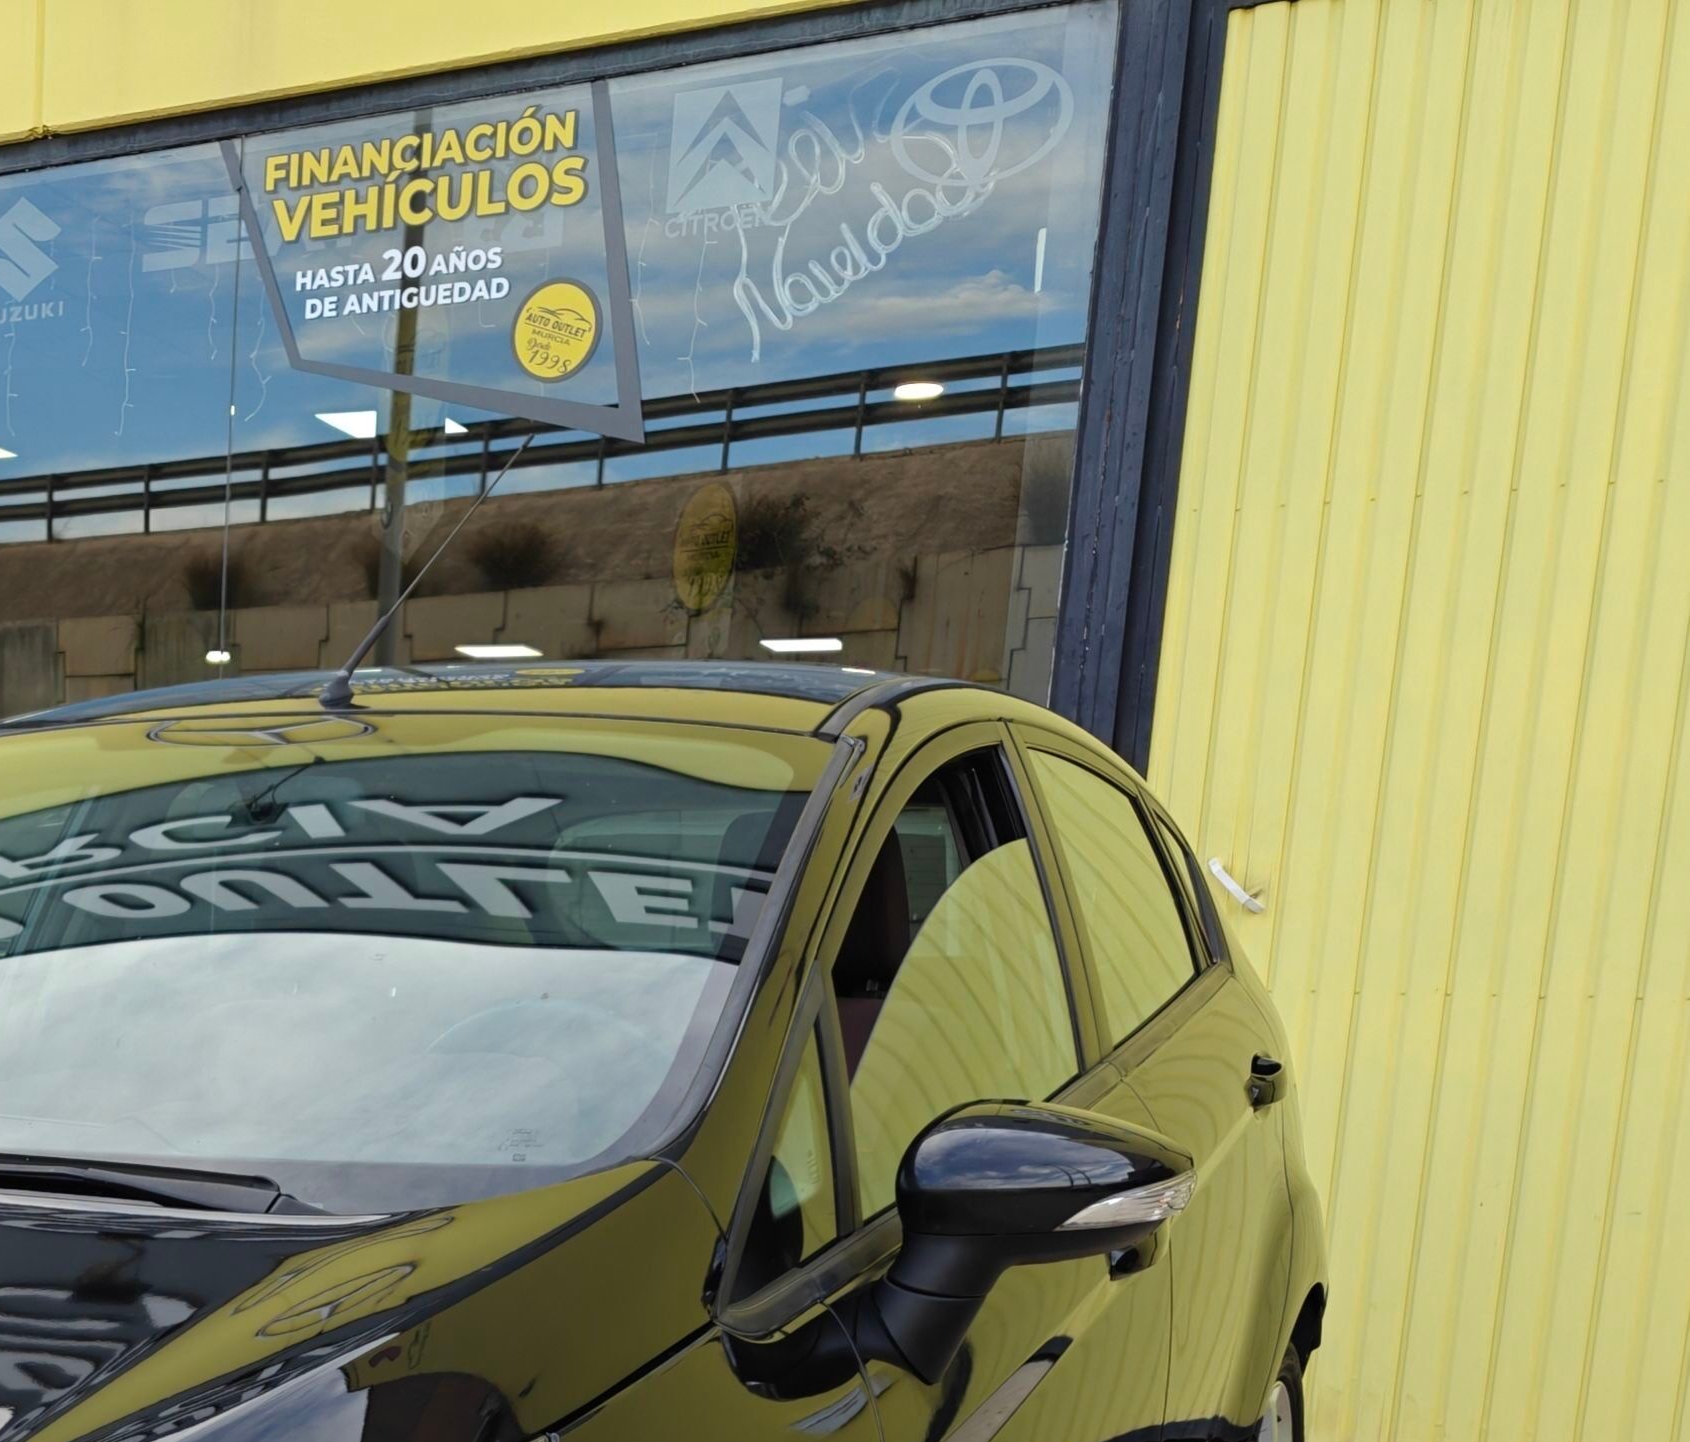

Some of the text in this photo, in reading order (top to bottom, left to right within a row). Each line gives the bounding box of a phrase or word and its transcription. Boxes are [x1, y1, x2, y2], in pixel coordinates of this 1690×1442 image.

[263, 106, 578, 193] FINANCIACIÓN
[272, 155, 588, 242] VEHÍCULOS
[295, 246, 503, 292] HASTA 20 AÑOS
[304, 276, 511, 320] DE ANTIGUEDAD
[525, 312, 587, 339] AUTO OUTLET
[531, 328, 571, 346] MURCIA
[529, 349, 572, 373] 1998
